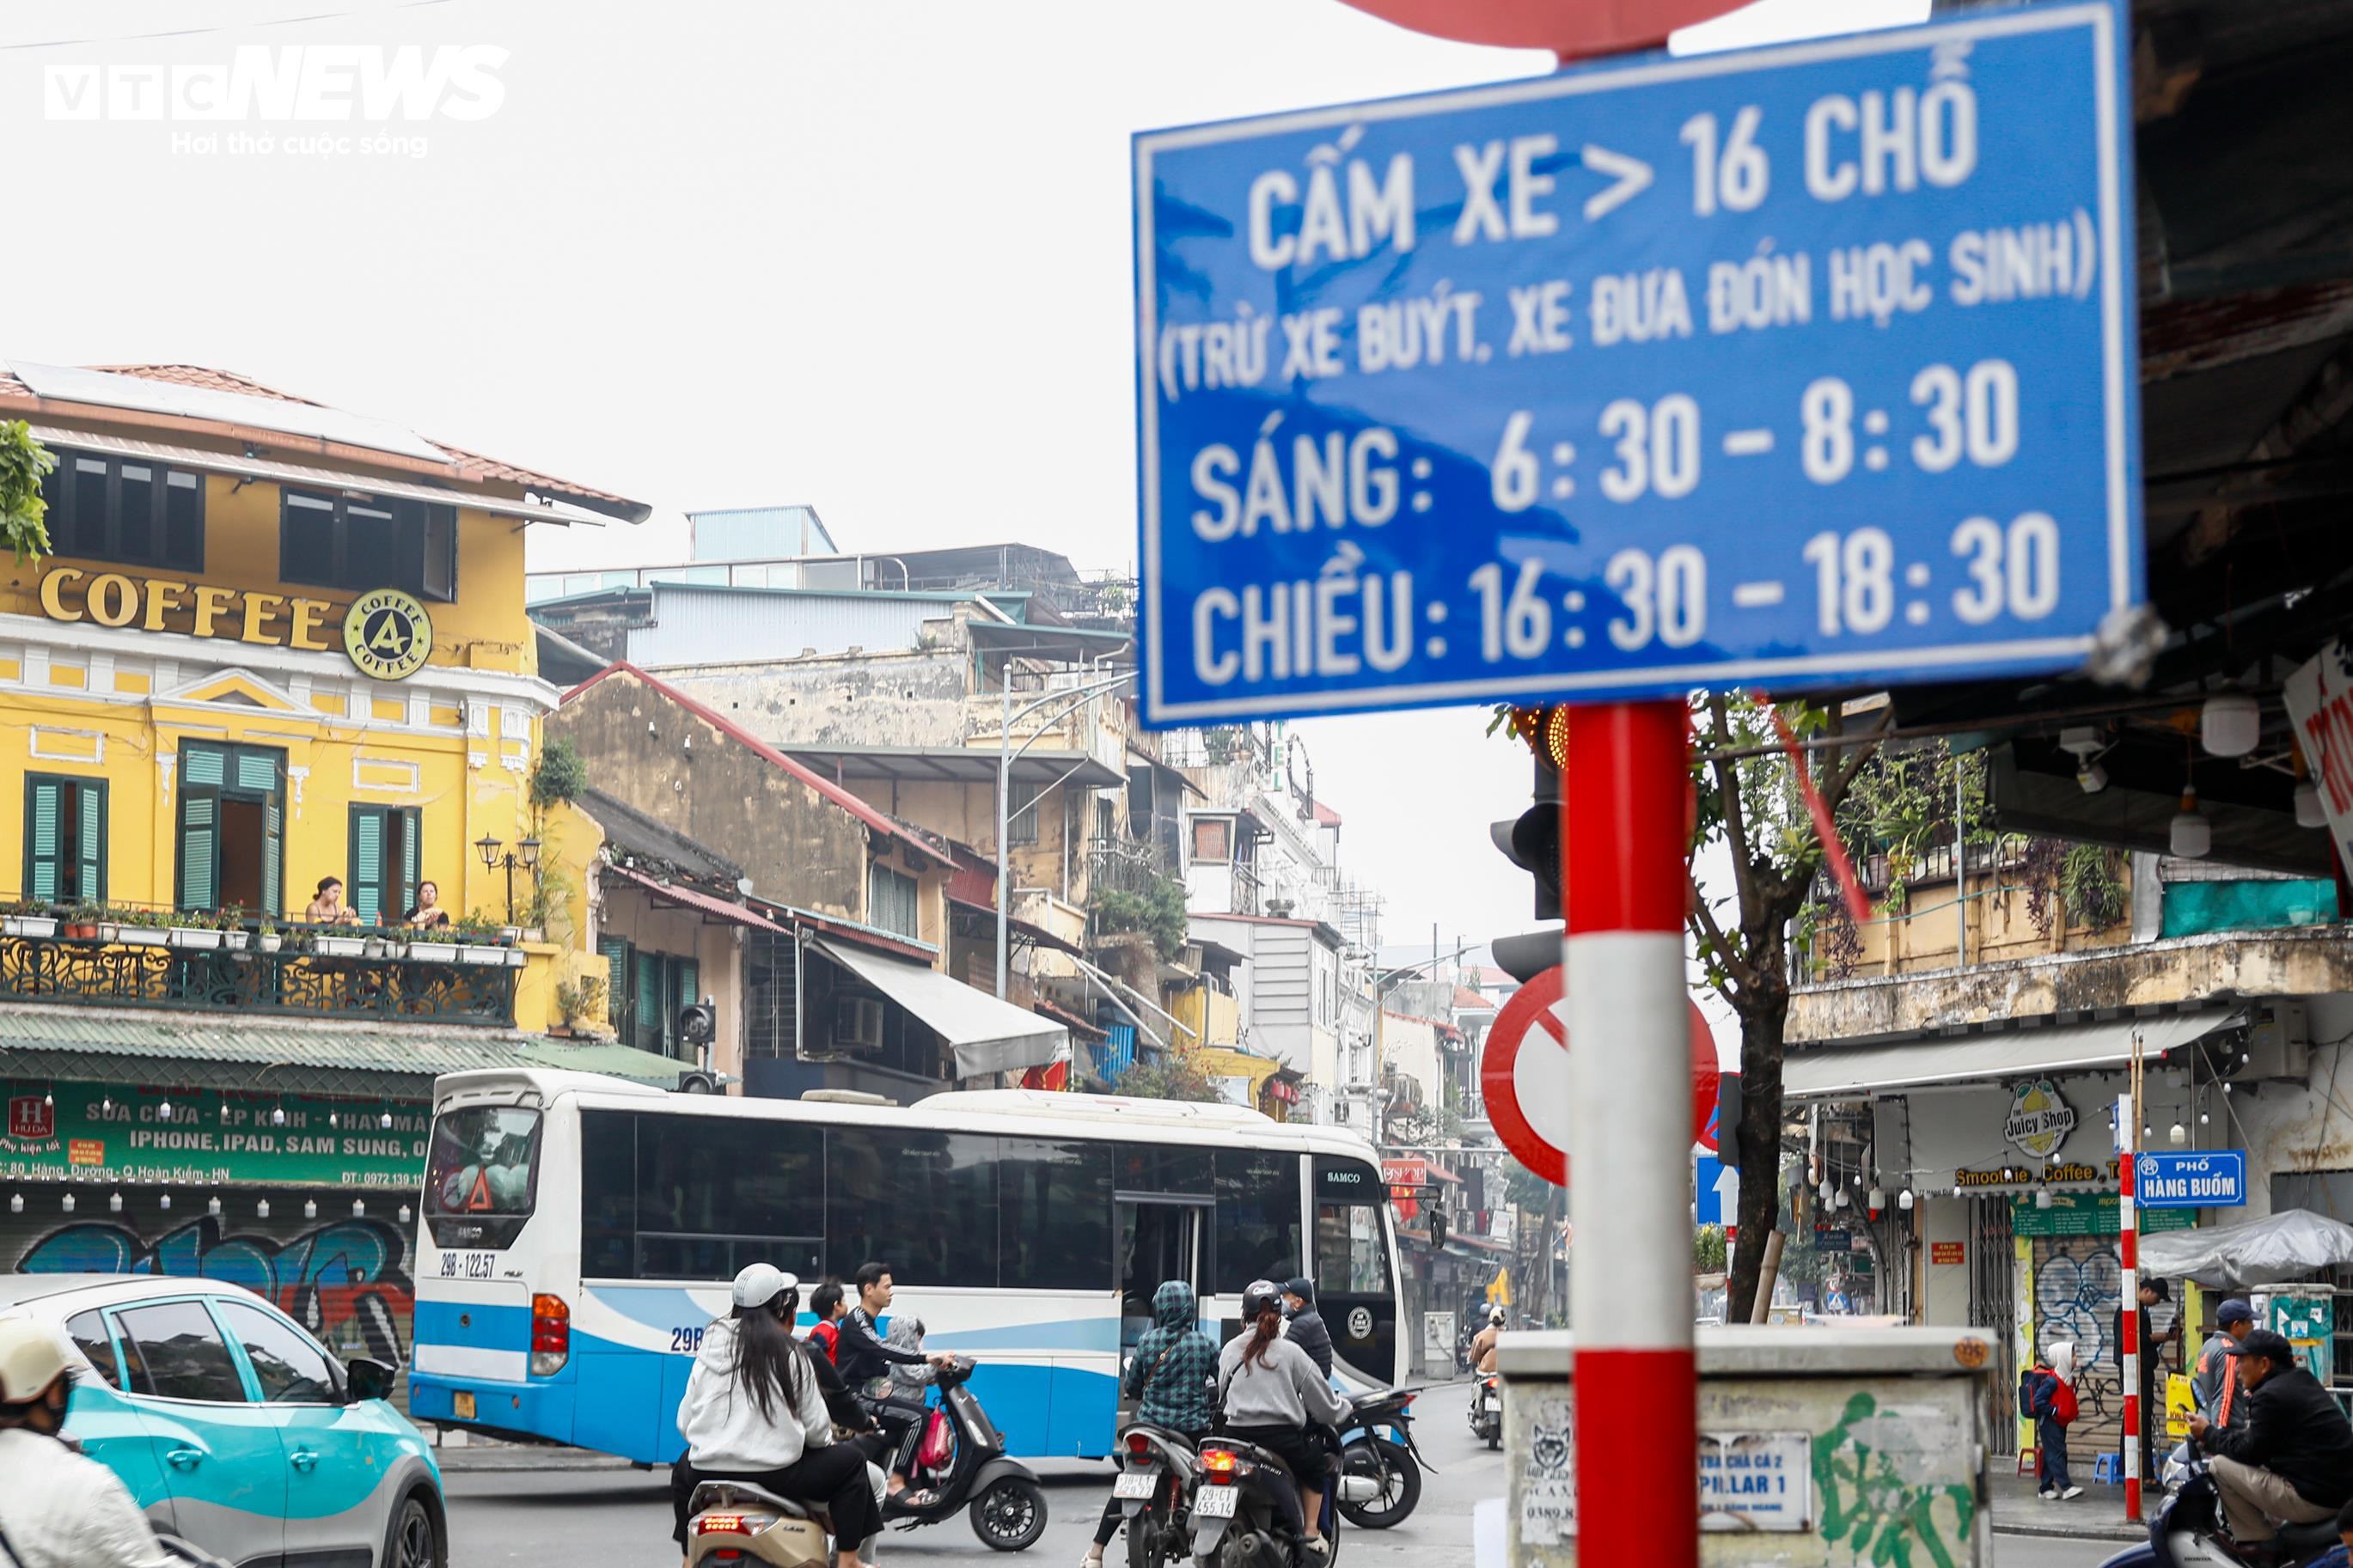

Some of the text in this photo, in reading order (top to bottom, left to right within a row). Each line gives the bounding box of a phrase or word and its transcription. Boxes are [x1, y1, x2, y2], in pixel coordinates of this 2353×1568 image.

[1250, 124, 1415, 272] CẤM
[1452, 133, 1559, 247] XE
[1679, 104, 1769, 217] 16
[1805, 40, 1977, 203] CHỖ
[1159, 300, 1272, 402] (TRỪ
[1281, 307, 1344, 381] XE
[1508, 280, 1573, 357] XE
[1706, 236, 1812, 336] ĐÓN
[1829, 238, 1932, 327] HỌC
[1950, 206, 2096, 307] SINH)
[40, 567, 331, 650] COFFEE
[361, 595, 423, 626] COFFEE
[355, 644, 419, 674] COFFEE
[19, 1101, 42, 1123] H
[2008, 1110, 2071, 1137] Juicy Shop
[130, 1131, 219, 1152] IPHONE,
[223, 1134, 280, 1154] IPAD,
[285, 1136, 335, 1155] SAM
[343, 1137, 407, 1158] SUNG,
[10, 1162, 25, 1174] 80
[212, 1168, 229, 1180] HN
[1956, 1166, 2029, 1187] Smoothie
[2044, 1163, 2093, 1181] Coffee
[2176, 1157, 2209, 1171] PHỐ
[364, 1173, 389, 1185] 0972
[392, 1174, 409, 1185] 139
[1328, 1172, 1360, 1184] SAMCO
[2145, 1175, 2187, 1198] HÀNG
[441, 1253, 457, 1277] 29B
[1776, 1474, 1785, 1494] 1
